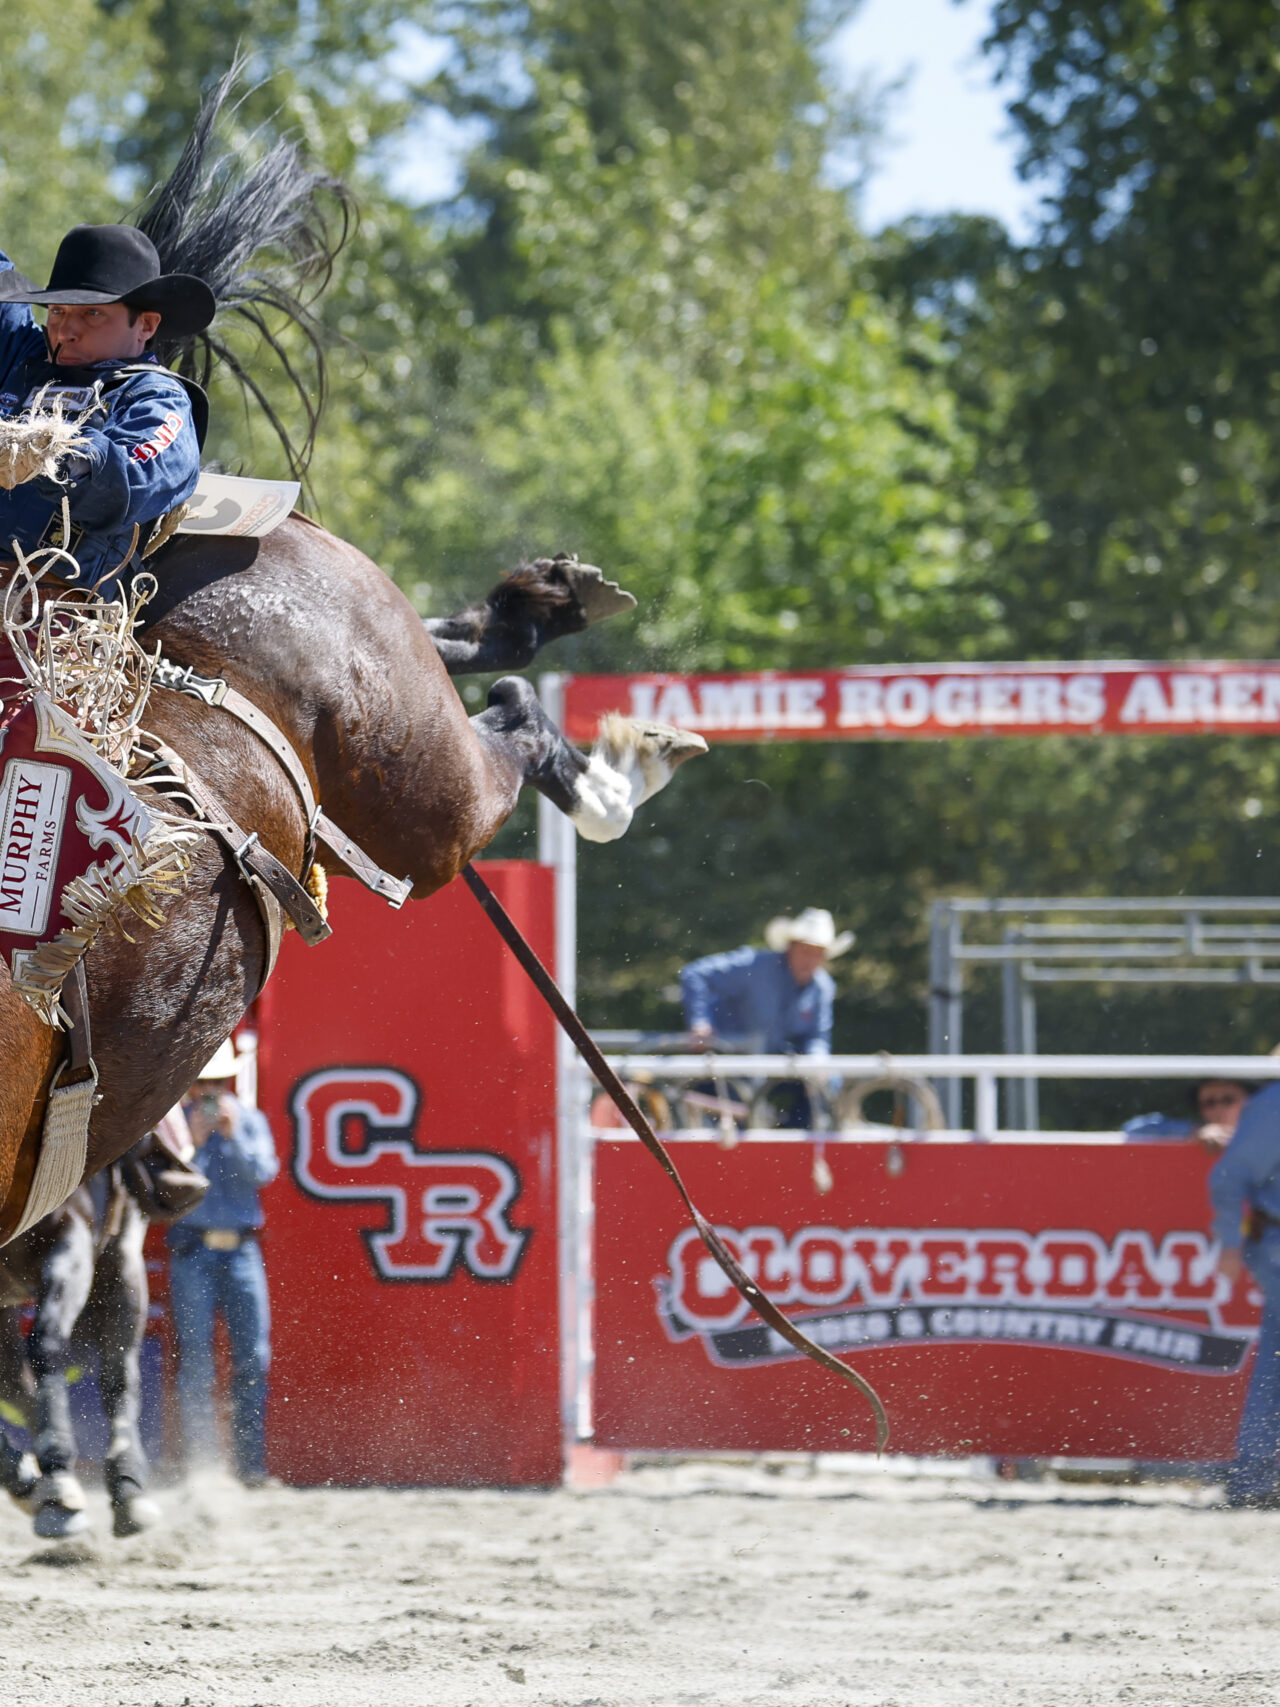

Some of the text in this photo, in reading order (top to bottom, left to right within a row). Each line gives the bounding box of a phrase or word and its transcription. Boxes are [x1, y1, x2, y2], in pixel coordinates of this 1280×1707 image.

[836, 675, 1107, 727] ROGERS
[35, 820, 57, 882] FARMS
[289, 1063, 533, 1286] CR
[929, 1308, 1107, 1346] COUNTRY
[1111, 1318, 1202, 1362] FAIR
